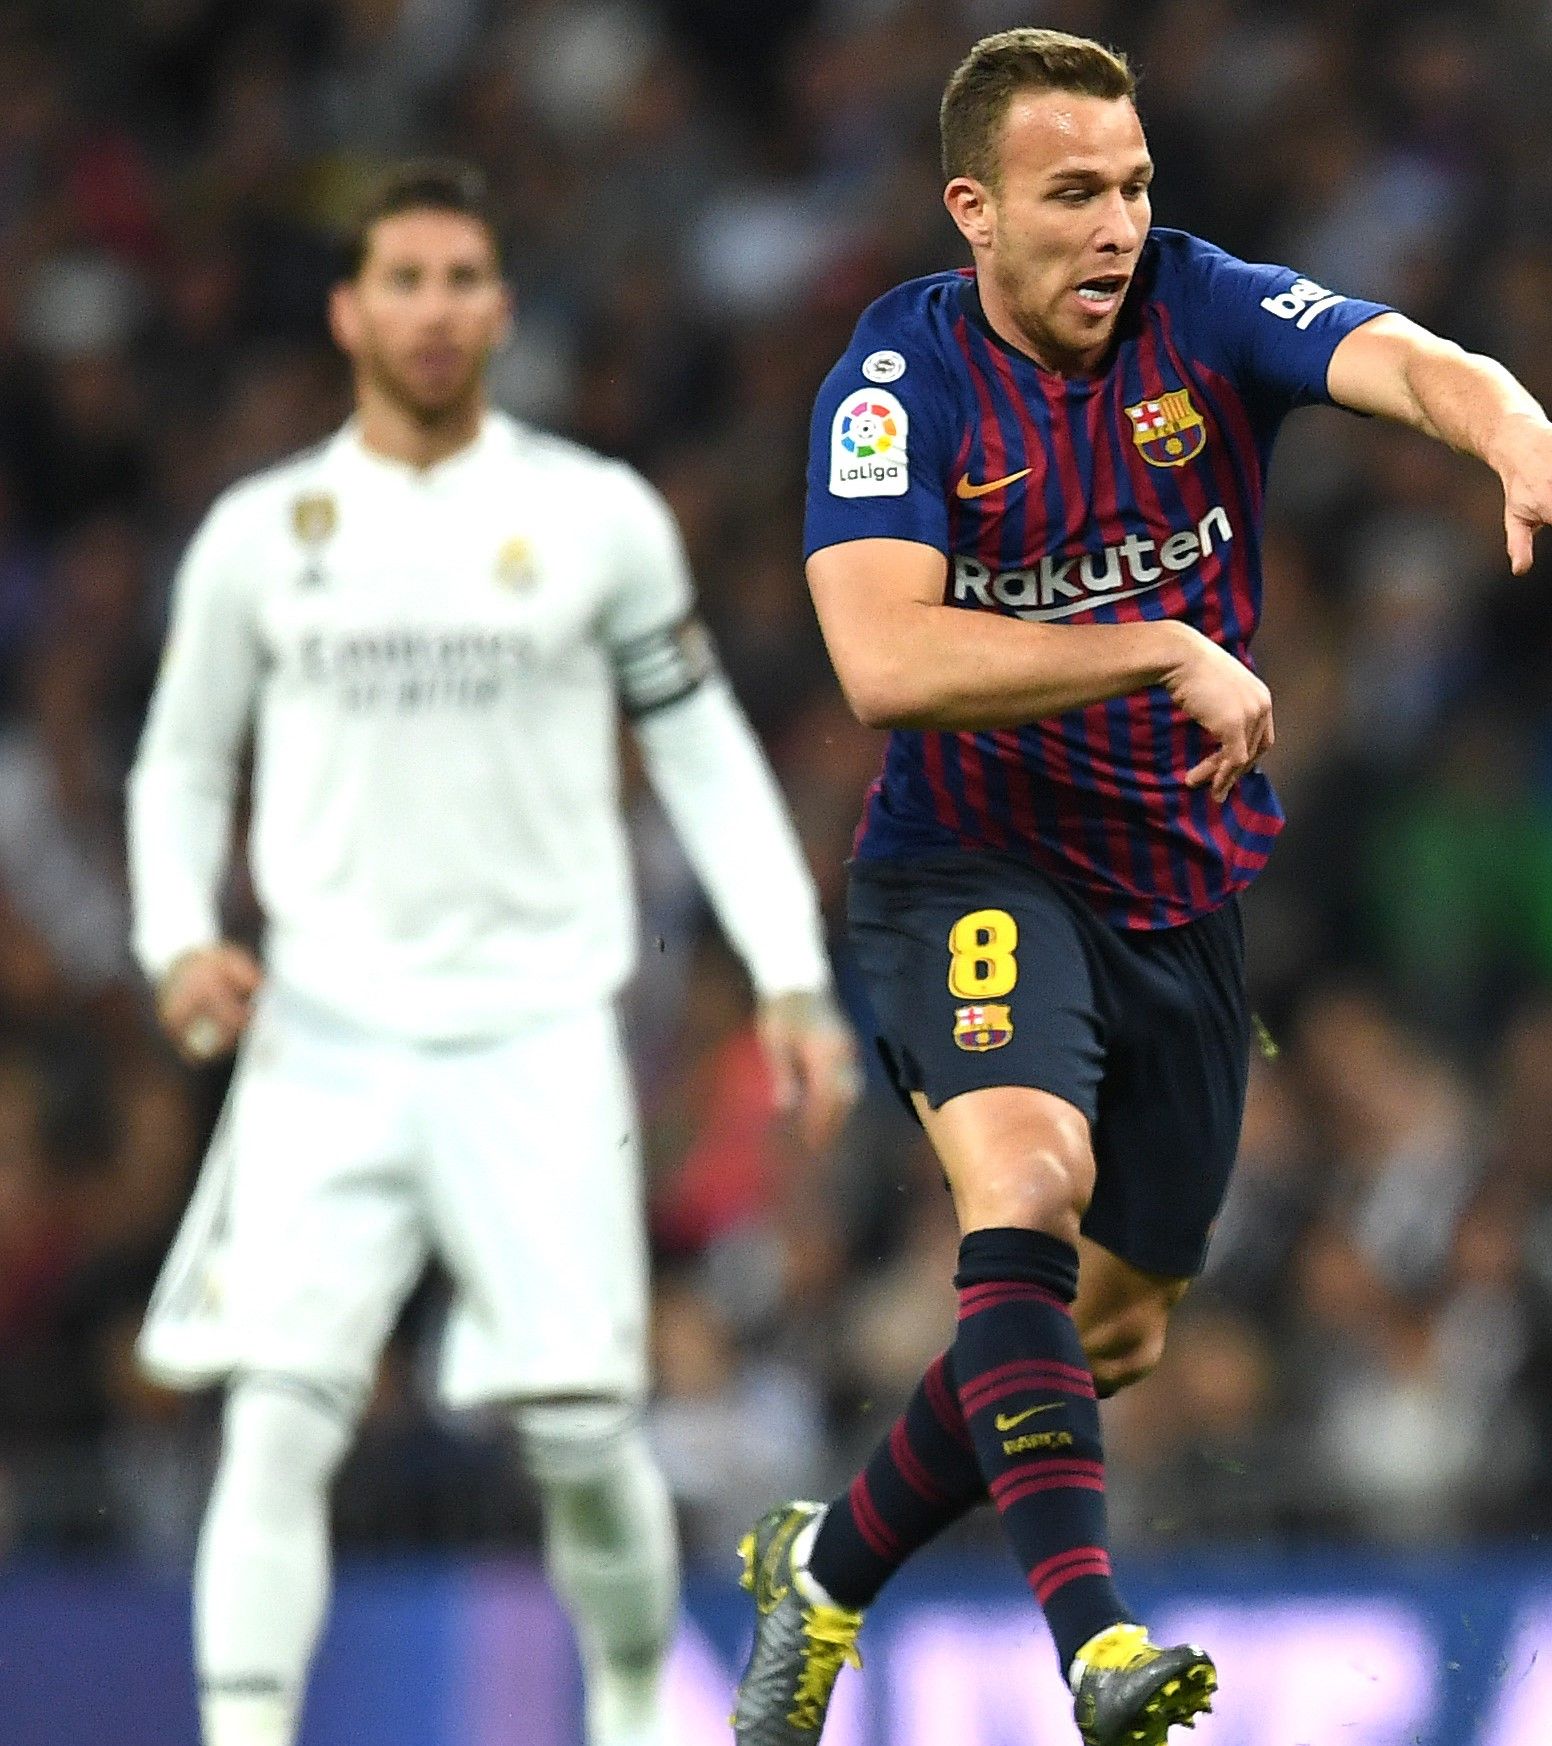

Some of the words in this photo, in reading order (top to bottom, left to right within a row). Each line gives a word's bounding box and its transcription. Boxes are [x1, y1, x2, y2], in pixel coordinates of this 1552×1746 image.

[840, 463, 898, 481] LaLiga
[953, 506, 1233, 606] Rakuten
[949, 908, 1018, 999] 8
